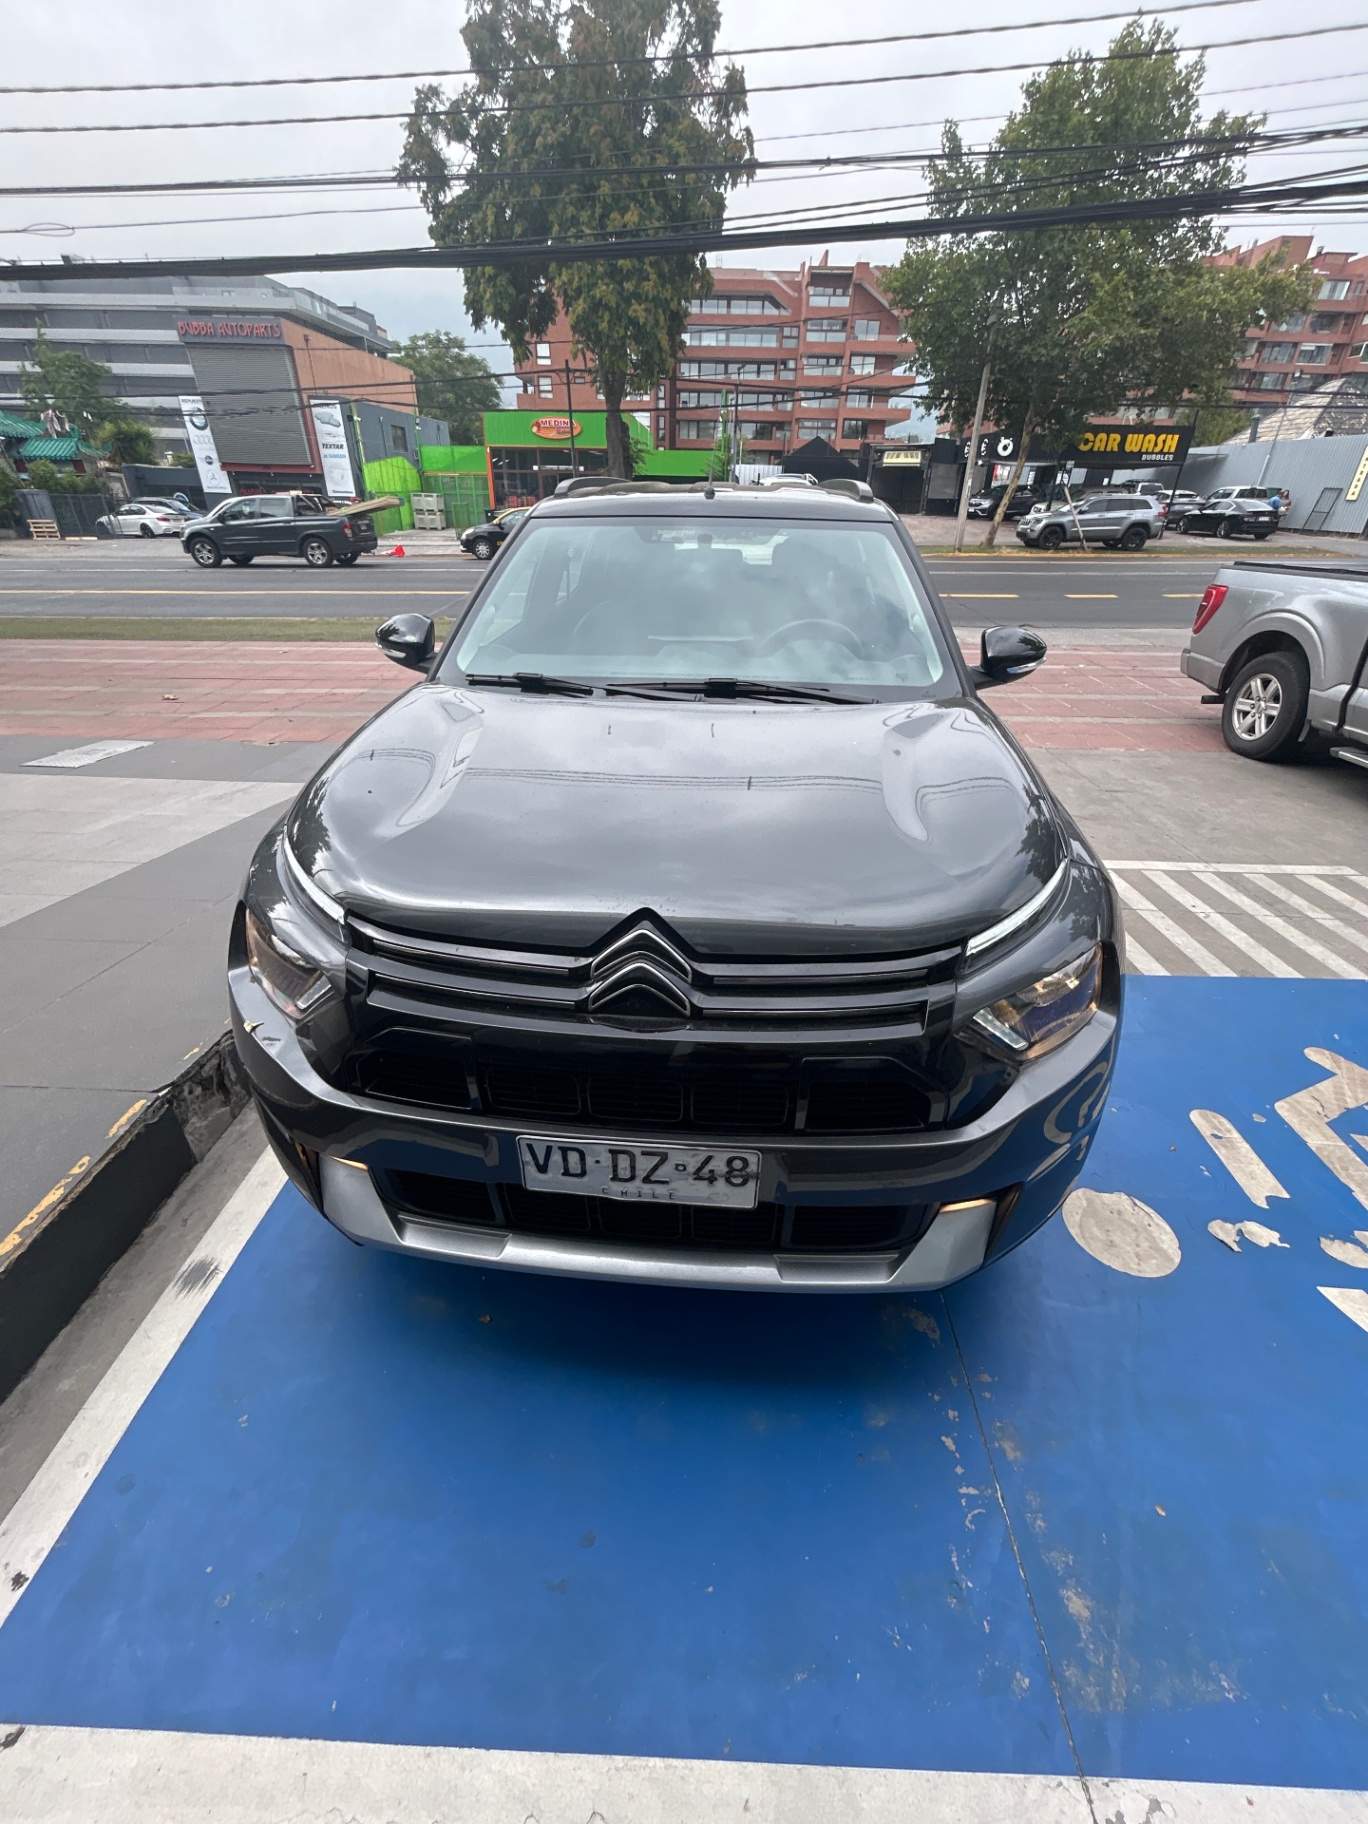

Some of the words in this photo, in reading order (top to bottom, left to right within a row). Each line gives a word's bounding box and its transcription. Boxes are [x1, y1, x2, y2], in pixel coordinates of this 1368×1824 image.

[218, 321, 281, 336] AUTOPARTS
[1078, 432, 1121, 452] CAR
[1124, 433, 1180, 453] WASH
[602, 1187, 676, 1200] CHILE
